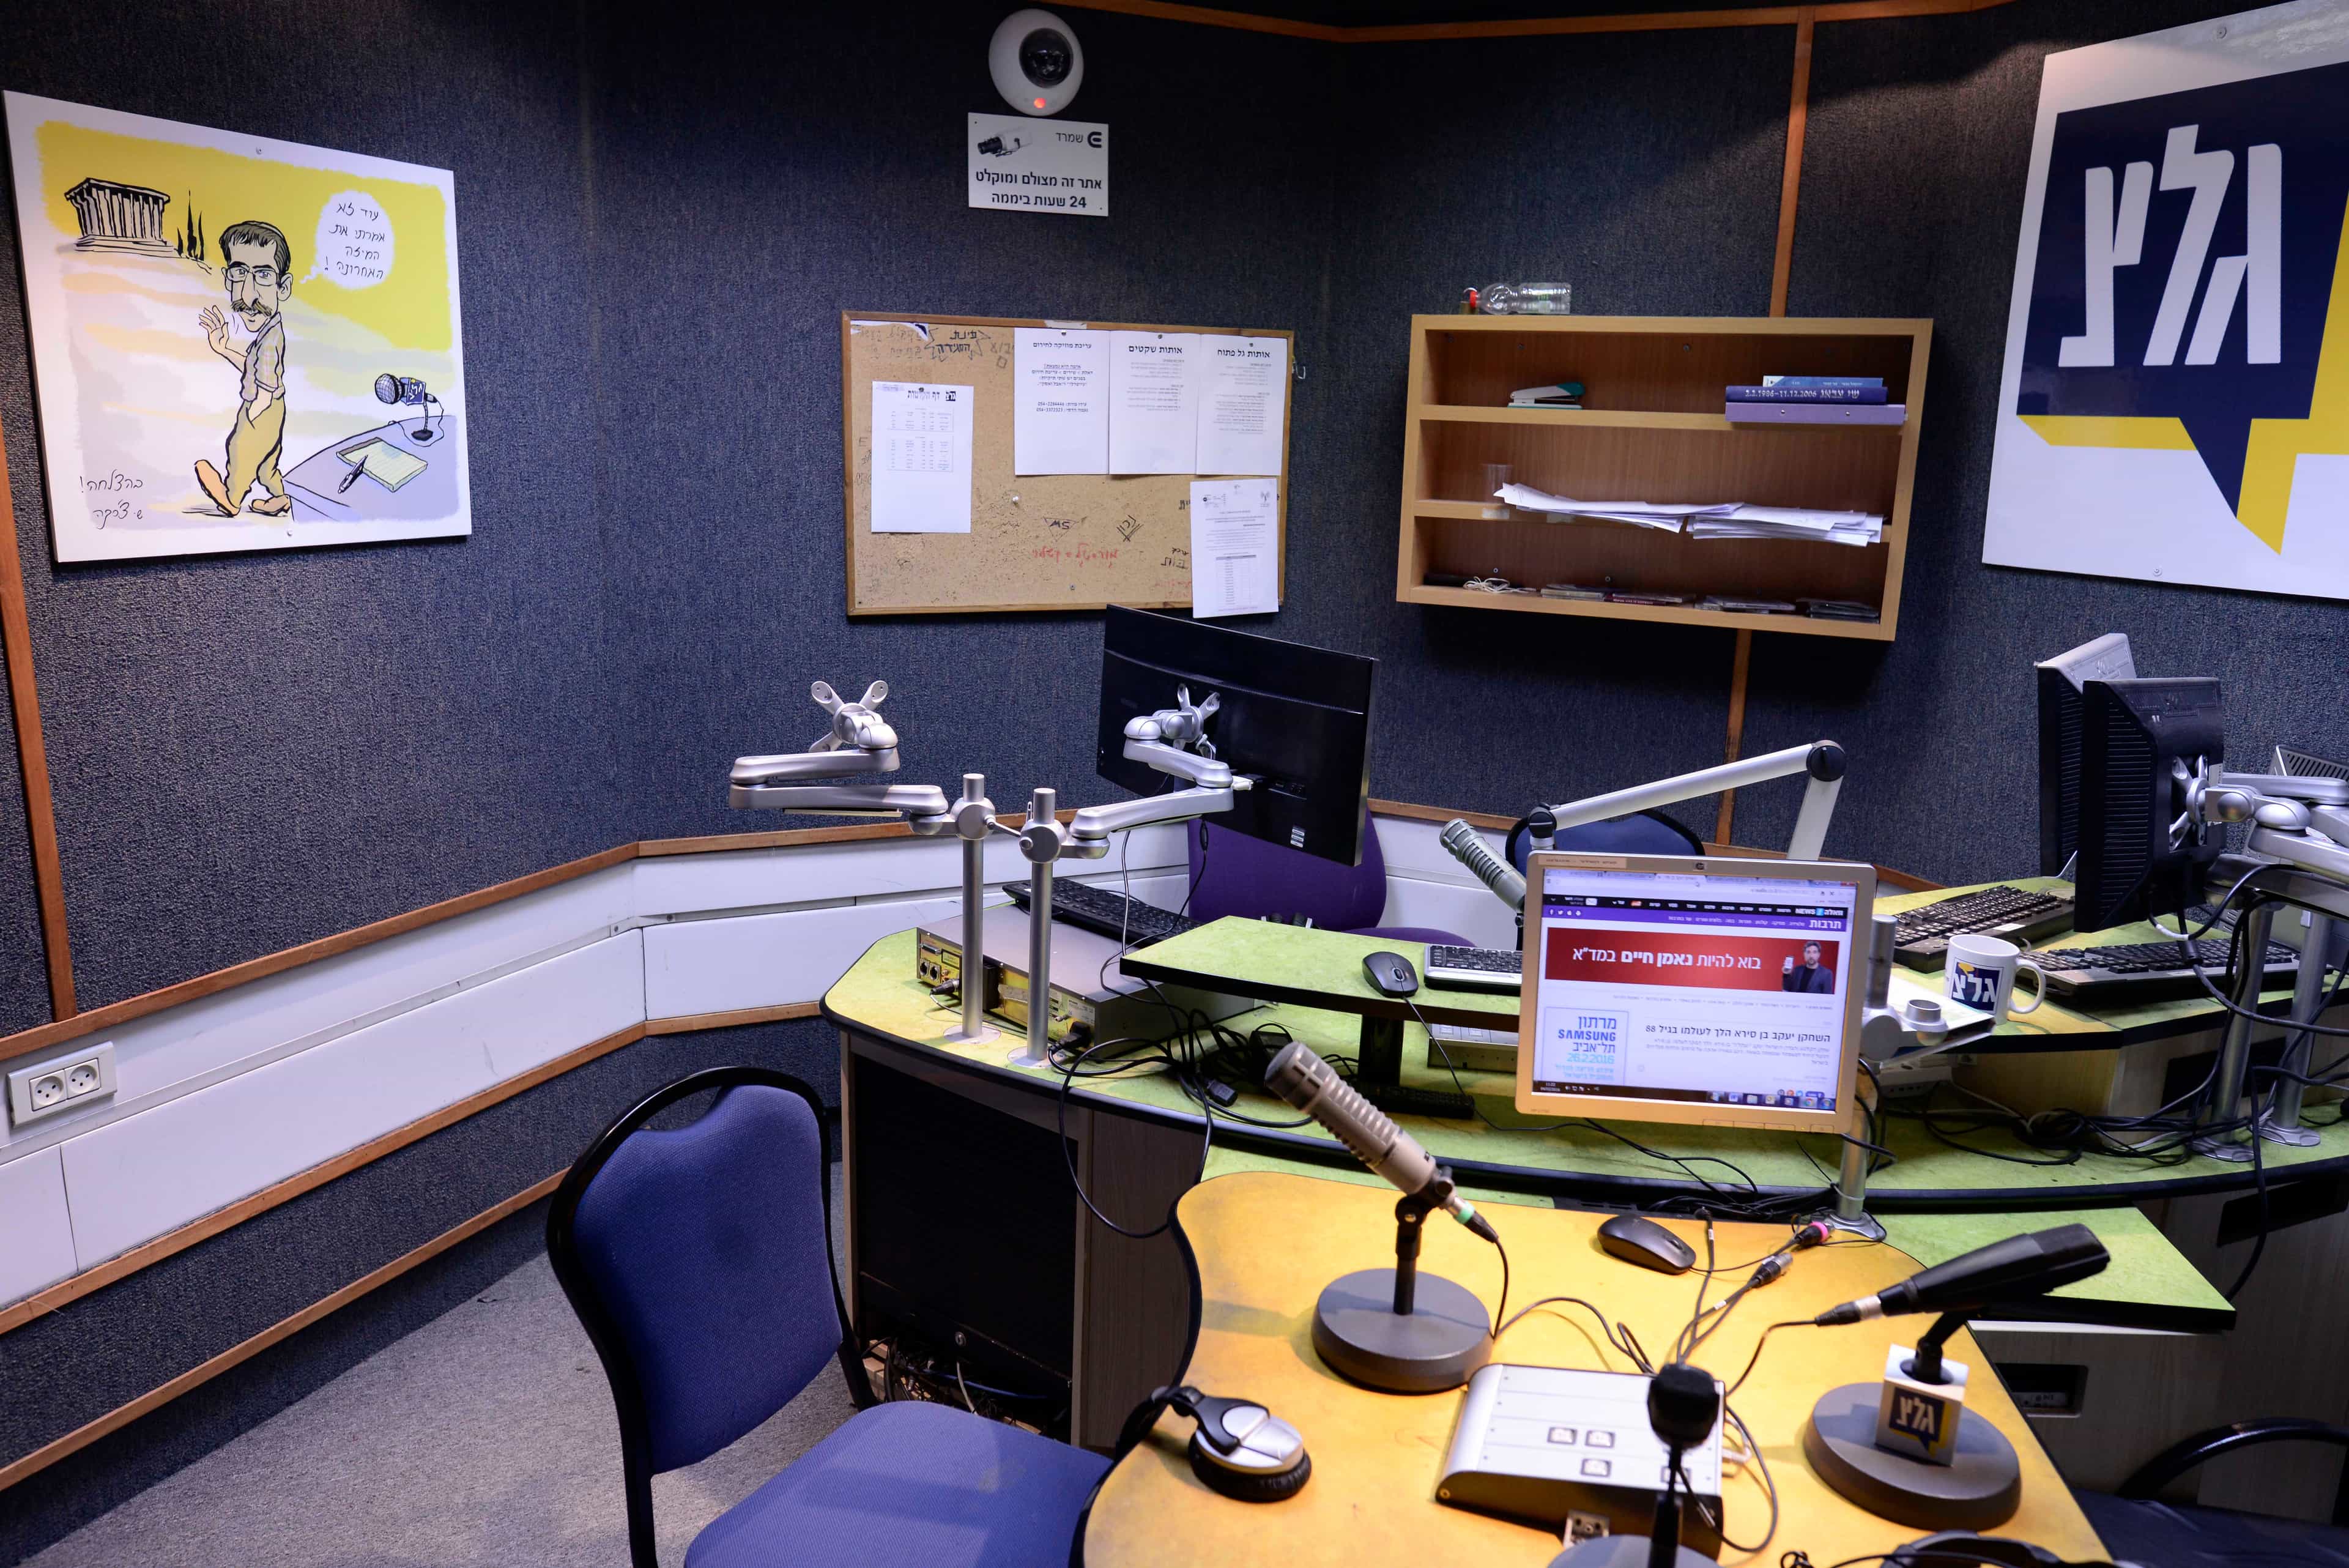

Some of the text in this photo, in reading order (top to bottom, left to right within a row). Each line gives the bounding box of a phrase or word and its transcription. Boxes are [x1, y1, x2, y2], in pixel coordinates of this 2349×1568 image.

[1055, 132, 1083, 143] שמרד
[976, 168, 1102, 190] אתר זה מצולם ומוקלט
[992, 193, 1087, 208] 24 שעות ביממה
[360, 208, 379, 221] עוד
[328, 224, 385, 242] אמרתי את
[2058, 124, 2282, 368] גלצ
[1129, 345, 1157, 354] שקטים
[1809, 919, 1842, 929] תרבות
[1621, 950, 1654, 964] חיים
[1657, 952, 1693, 968] נאמן
[1696, 953, 1734, 968] להיות
[1737, 956, 1762, 969] בוא
[1952, 972, 1997, 1002] גלצ
[1578, 1016, 1617, 1030] מרתון
[1659, 1024, 1678, 1034] בגיל
[1558, 1029, 1616, 1042] SAMSUNG
[1681, 1026, 1711, 1036] לעולמו
[1714, 1028, 1731, 1038] הלך
[1760, 1031, 1768, 1040] בן
[1798, 1034, 1831, 1043] השחקן
[1896, 1395, 1935, 1435] גלצ
